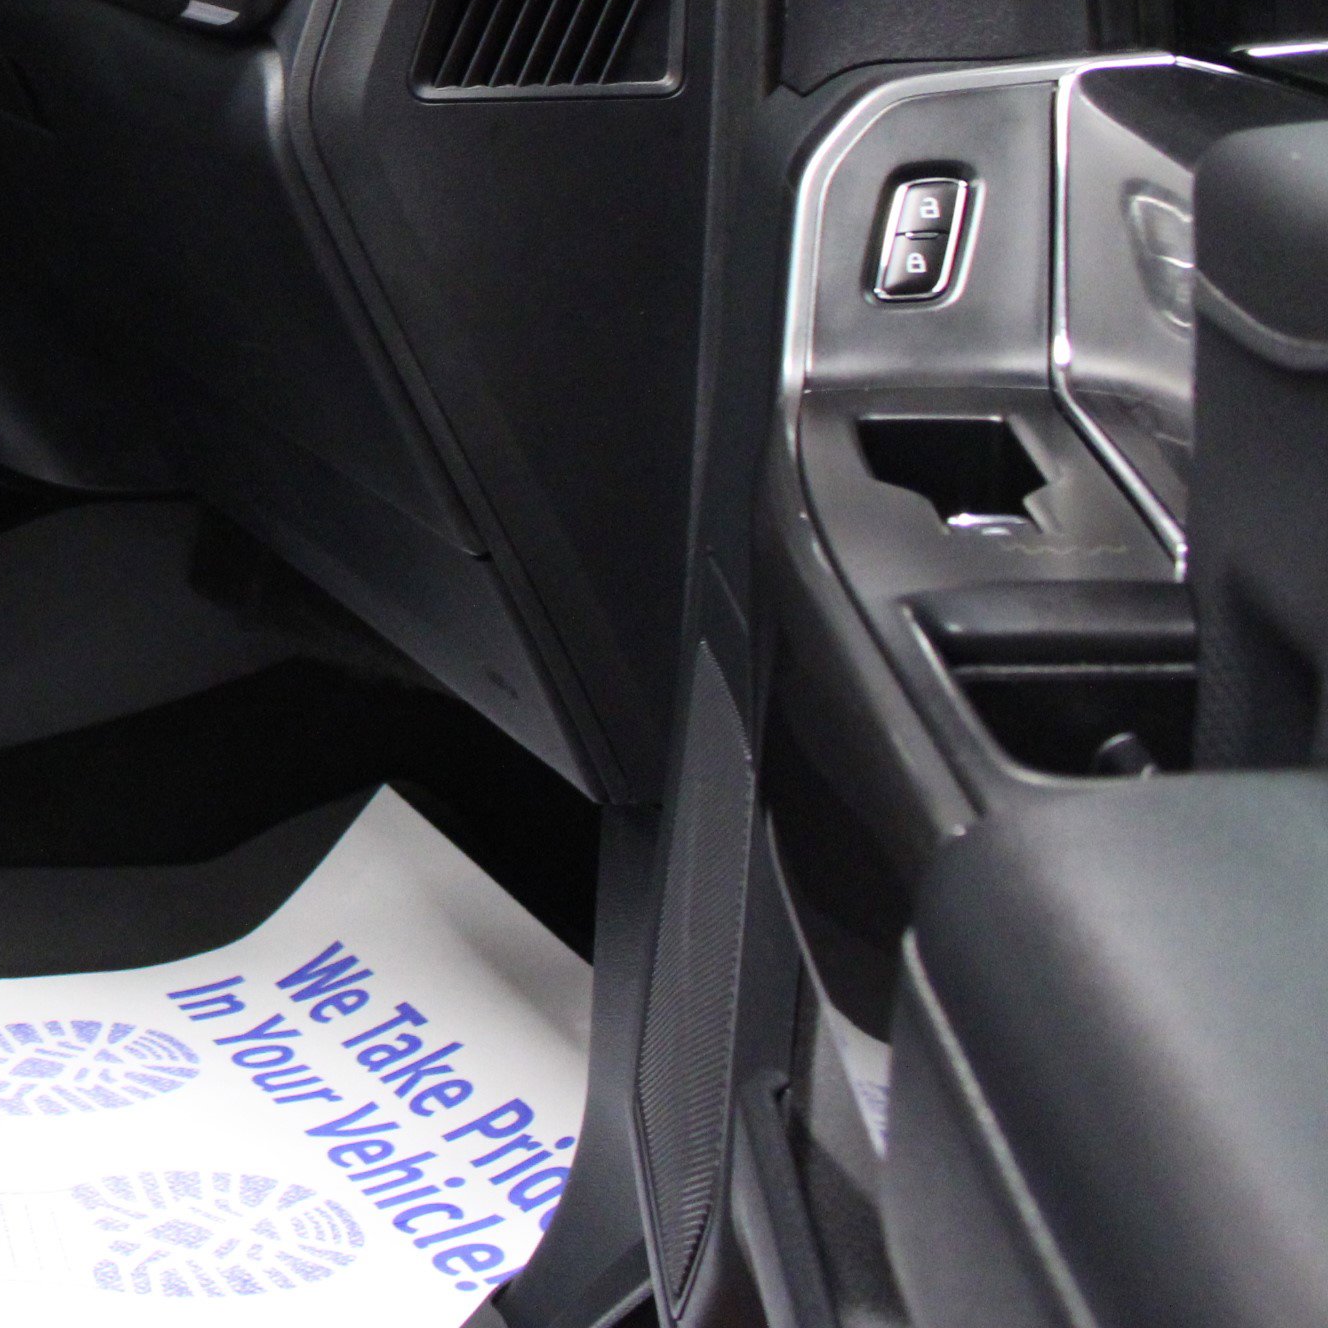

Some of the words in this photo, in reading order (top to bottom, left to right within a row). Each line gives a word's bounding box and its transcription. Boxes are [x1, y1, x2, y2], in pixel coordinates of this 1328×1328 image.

[166, 975, 247, 1021] In
[213, 1013, 343, 1104] Your
[304, 1101, 528, 1292] Vehicle!
[276, 940, 374, 1023] We
[341, 1002, 474, 1118] Take
[441, 1098, 576, 1232] Prid
